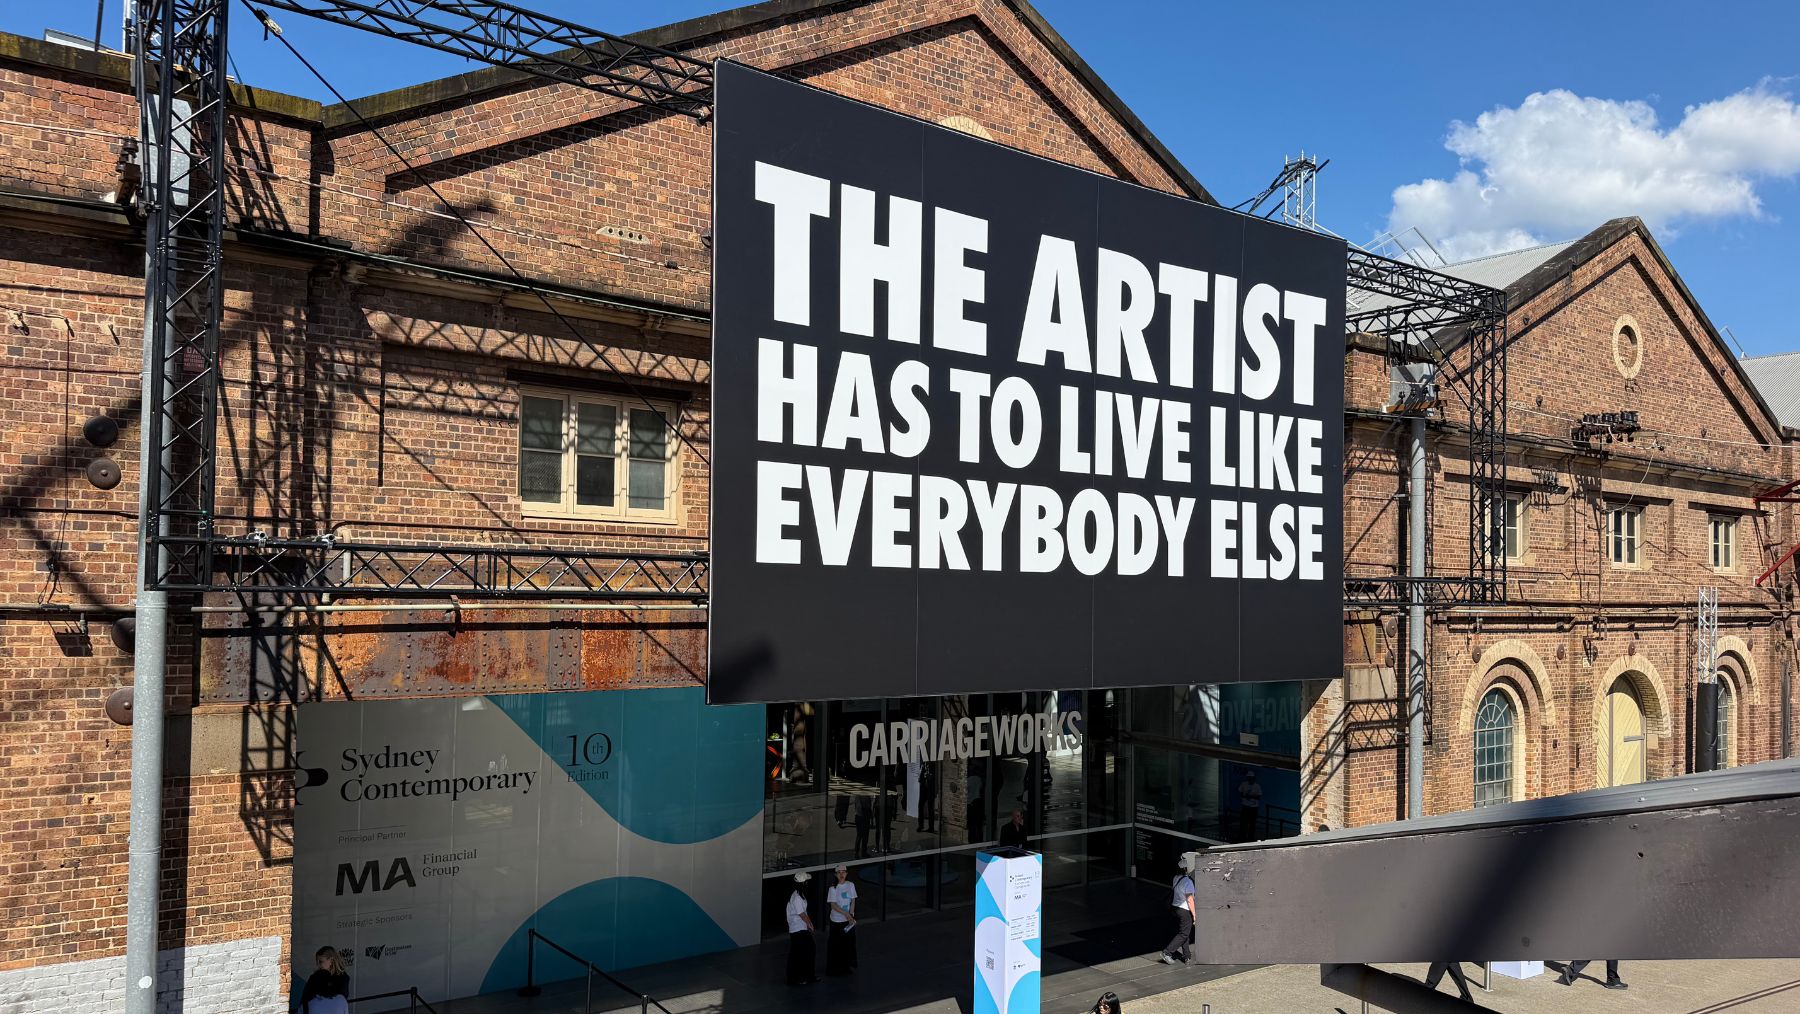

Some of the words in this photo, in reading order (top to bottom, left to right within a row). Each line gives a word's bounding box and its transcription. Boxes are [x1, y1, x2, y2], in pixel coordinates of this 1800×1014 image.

[755, 161, 989, 357] THE
[1017, 233, 1327, 407] ARTIST
[757, 338, 931, 458] HAS
[949, 368, 1043, 469] TO
[1059, 384, 1192, 483] LIVE
[1210, 406, 1323, 494] LIKE
[755, 461, 1197, 577] EVERYBODY
[1210, 499, 1324, 581] ELSE
[849, 710, 1083, 769] CARRIAGEWORKS
[340, 745, 441, 778] Sydney
[567, 769, 609, 783] Edition
[339, 771, 538, 802] Contemporary
[338, 833, 375, 845] Principal
[377, 831, 407, 841] Partner
[335, 856, 417, 897] MA
[423, 849, 478, 865] Financial
[422, 864, 460, 878] Group
[375, 914, 413, 926] Sponsors
